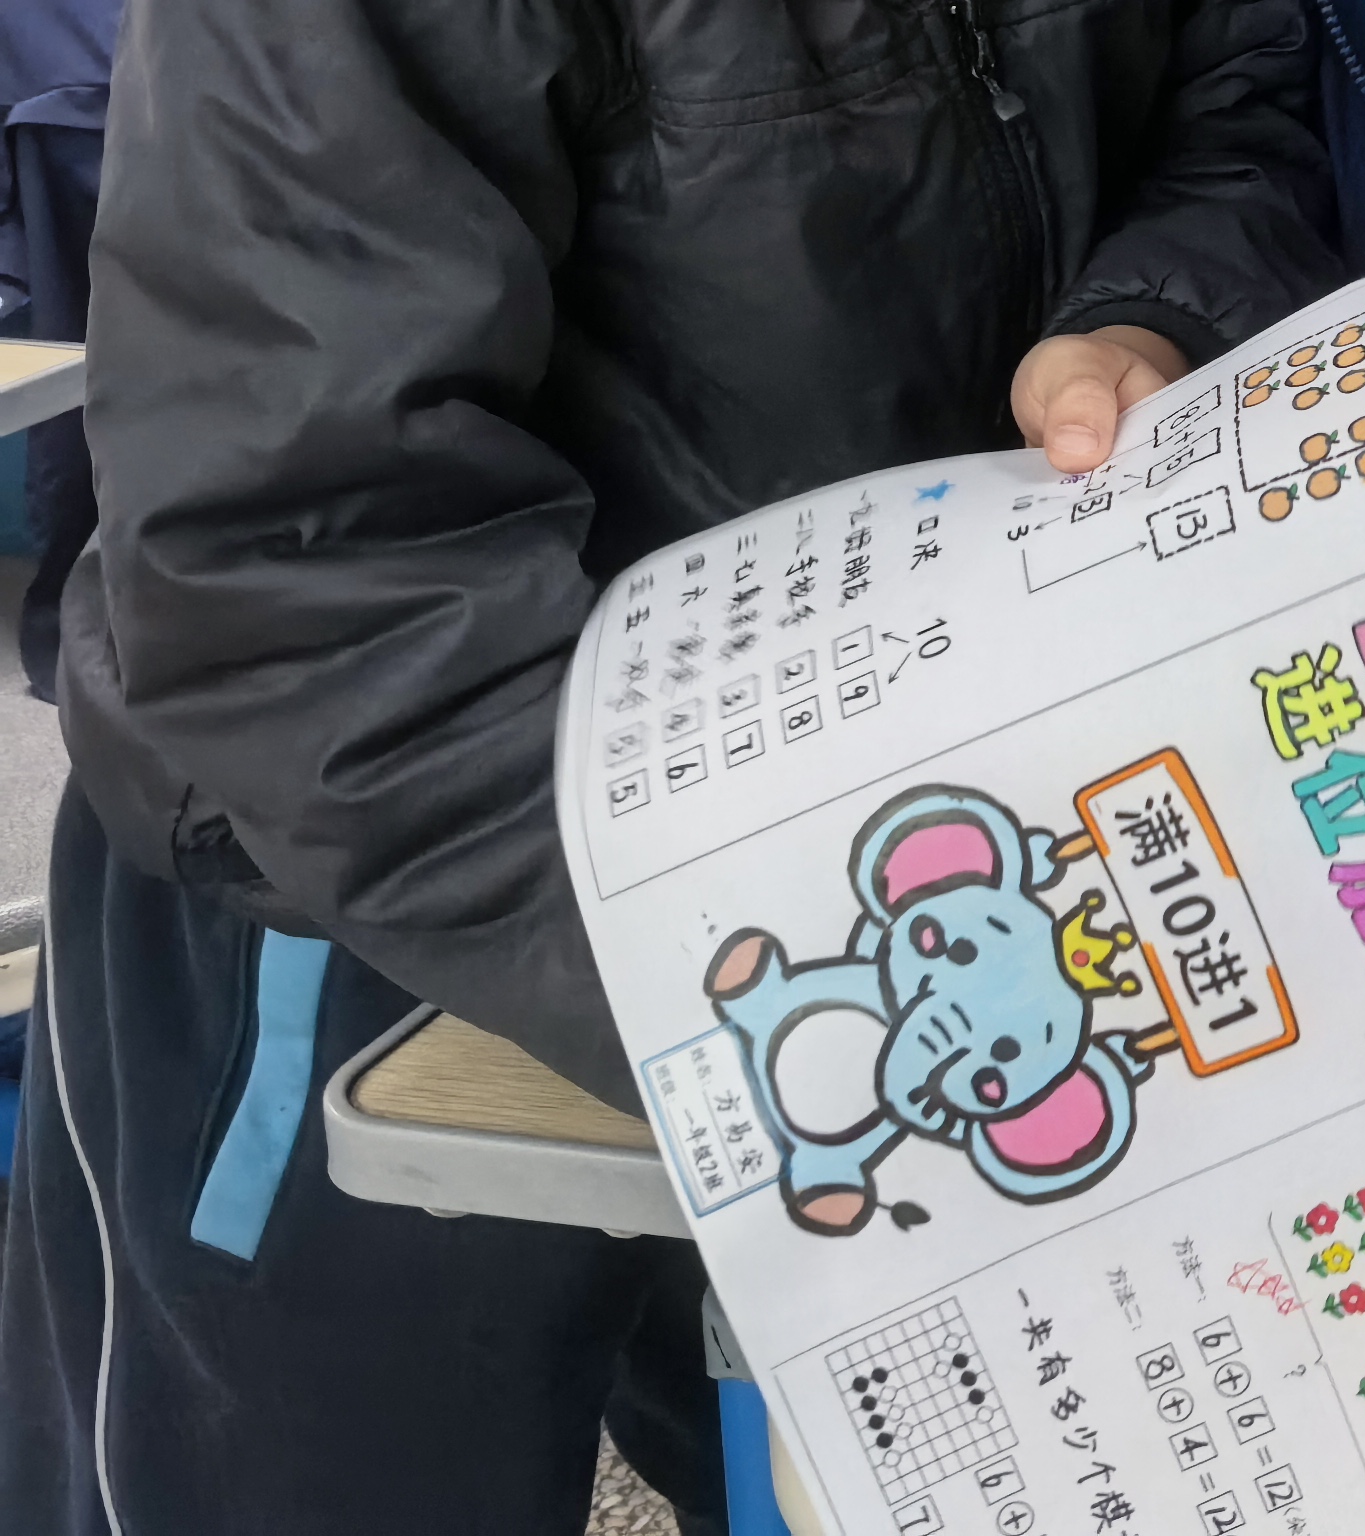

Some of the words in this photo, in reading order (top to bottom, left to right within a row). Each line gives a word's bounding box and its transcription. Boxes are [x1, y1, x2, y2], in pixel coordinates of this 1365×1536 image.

[915, 616, 952, 661] 10
[1115, 792, 1258, 1031] 满10进1
[1018, 1289, 1136, 1536] 一共有多少个棋
